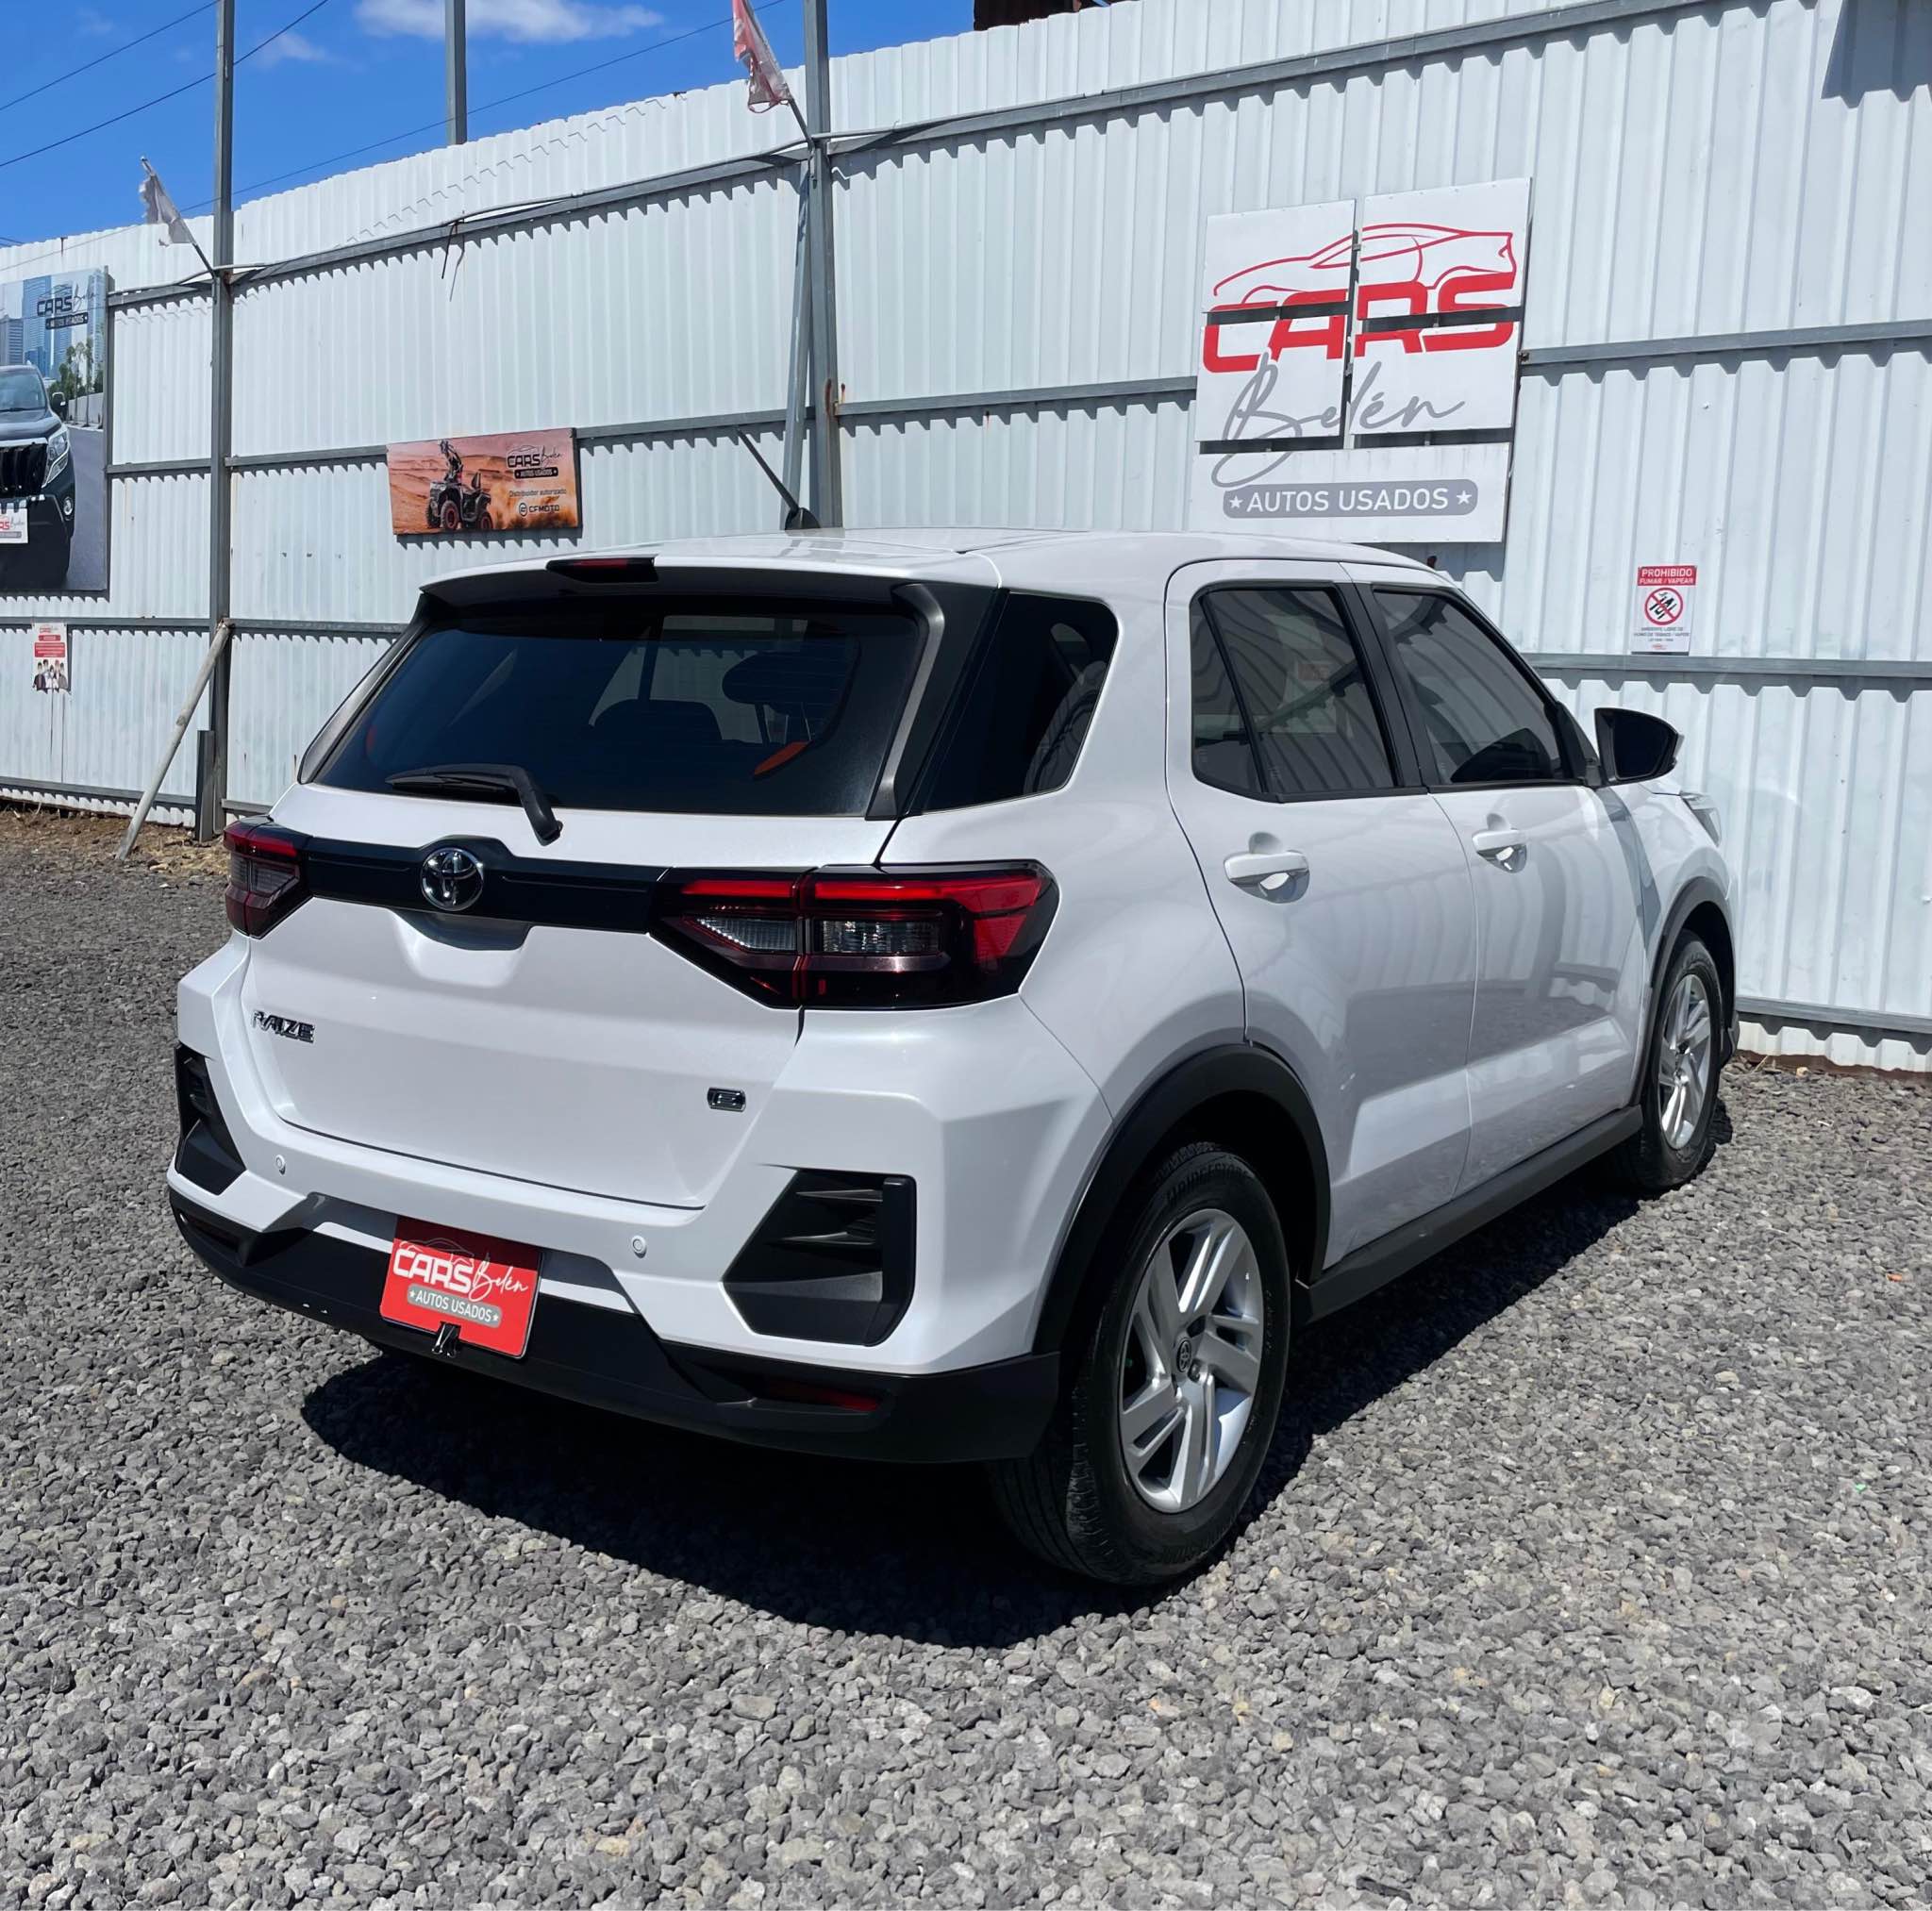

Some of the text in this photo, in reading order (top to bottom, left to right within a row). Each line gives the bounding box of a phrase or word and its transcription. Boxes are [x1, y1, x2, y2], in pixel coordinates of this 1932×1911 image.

[37, 296, 72, 317] CARS
[1203, 274, 1514, 373] CARS
[1211, 352, 1466, 488] Belén
[508, 454, 541, 468] CARS
[1246, 488, 1449, 512] AUTOS USADOS
[1641, 568, 1693, 577] PROHIBIDO
[252, 1009, 315, 1043] RAIZE
[392, 1248, 473, 1293] CARS
[416, 1289, 491, 1322] AUTOS USADOS
